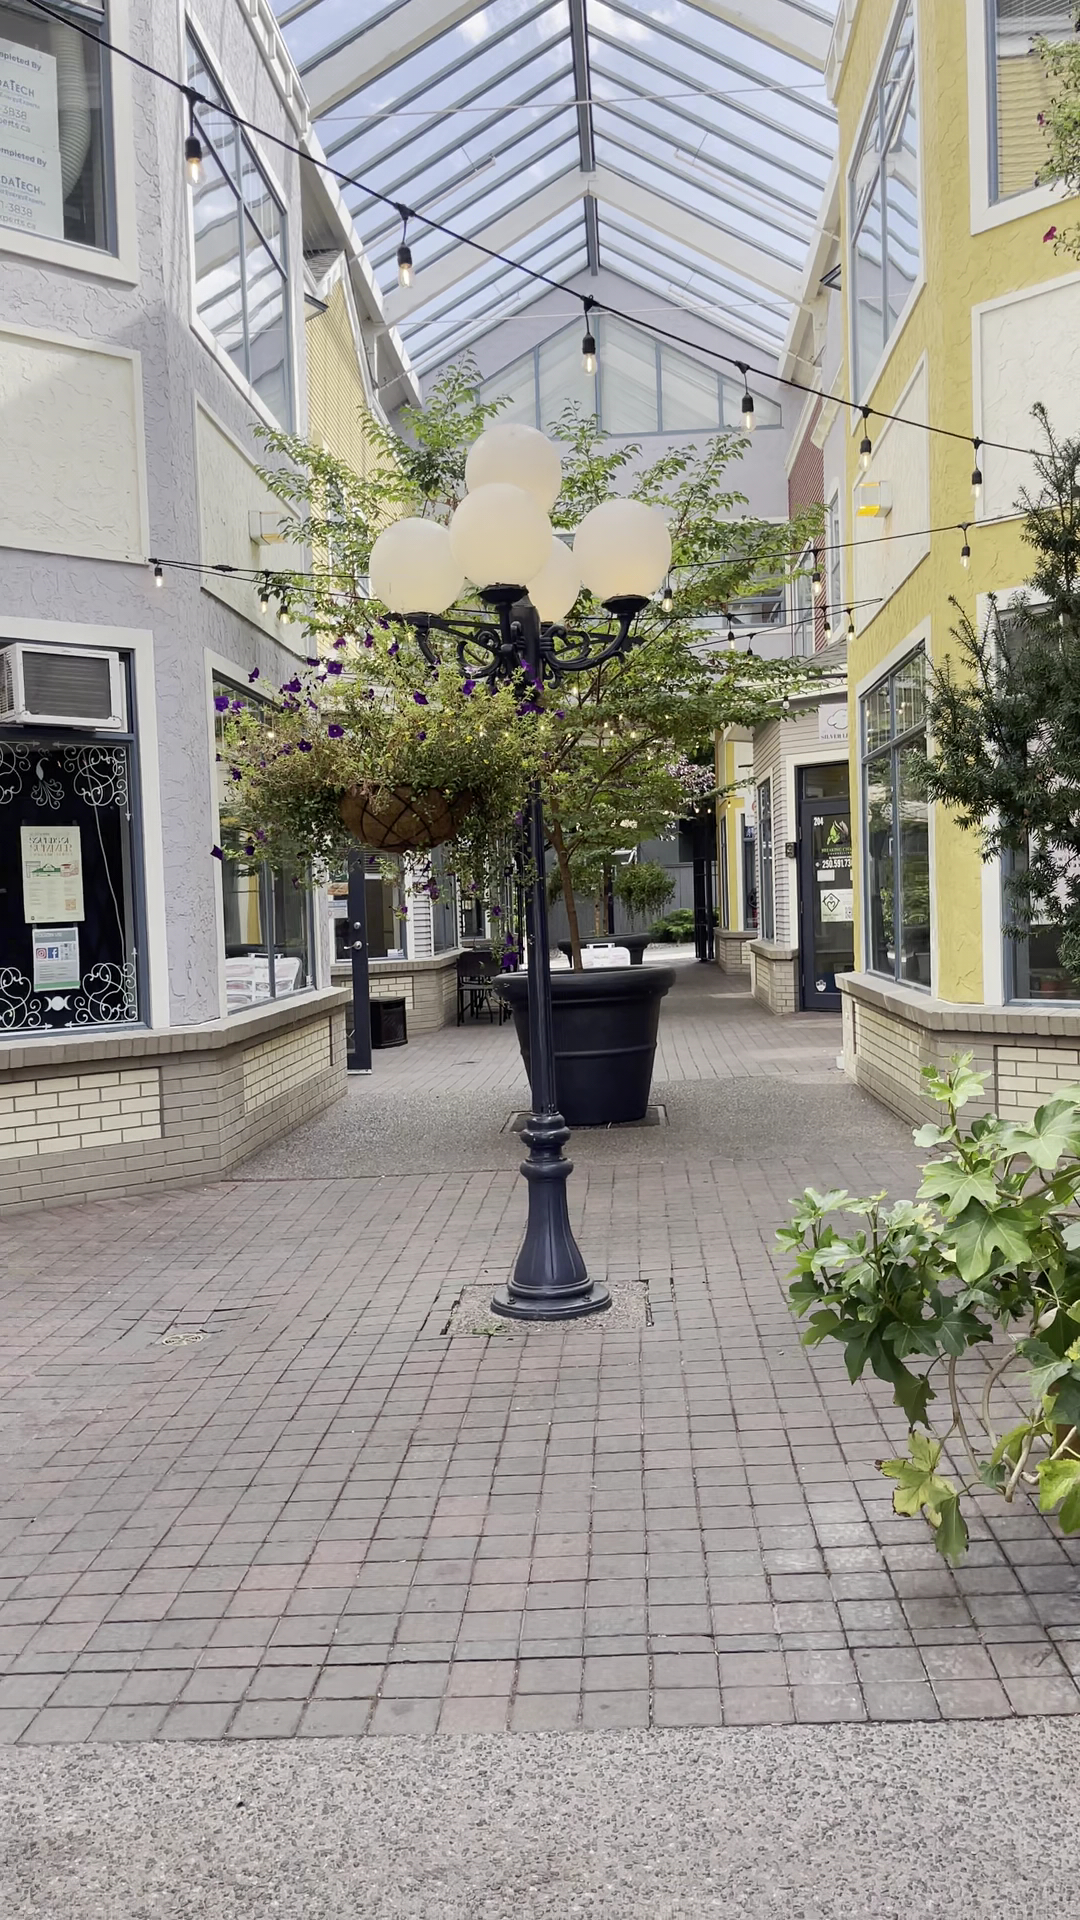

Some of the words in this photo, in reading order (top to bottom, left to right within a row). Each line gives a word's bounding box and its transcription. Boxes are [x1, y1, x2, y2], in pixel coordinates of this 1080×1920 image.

[31, 61, 42, 71] By
[0, 147, 35, 163] mpleted
[36, 157, 47, 168] By
[813, 816, 824, 826] 204
[822, 859, 851, 868] 250.591.73
